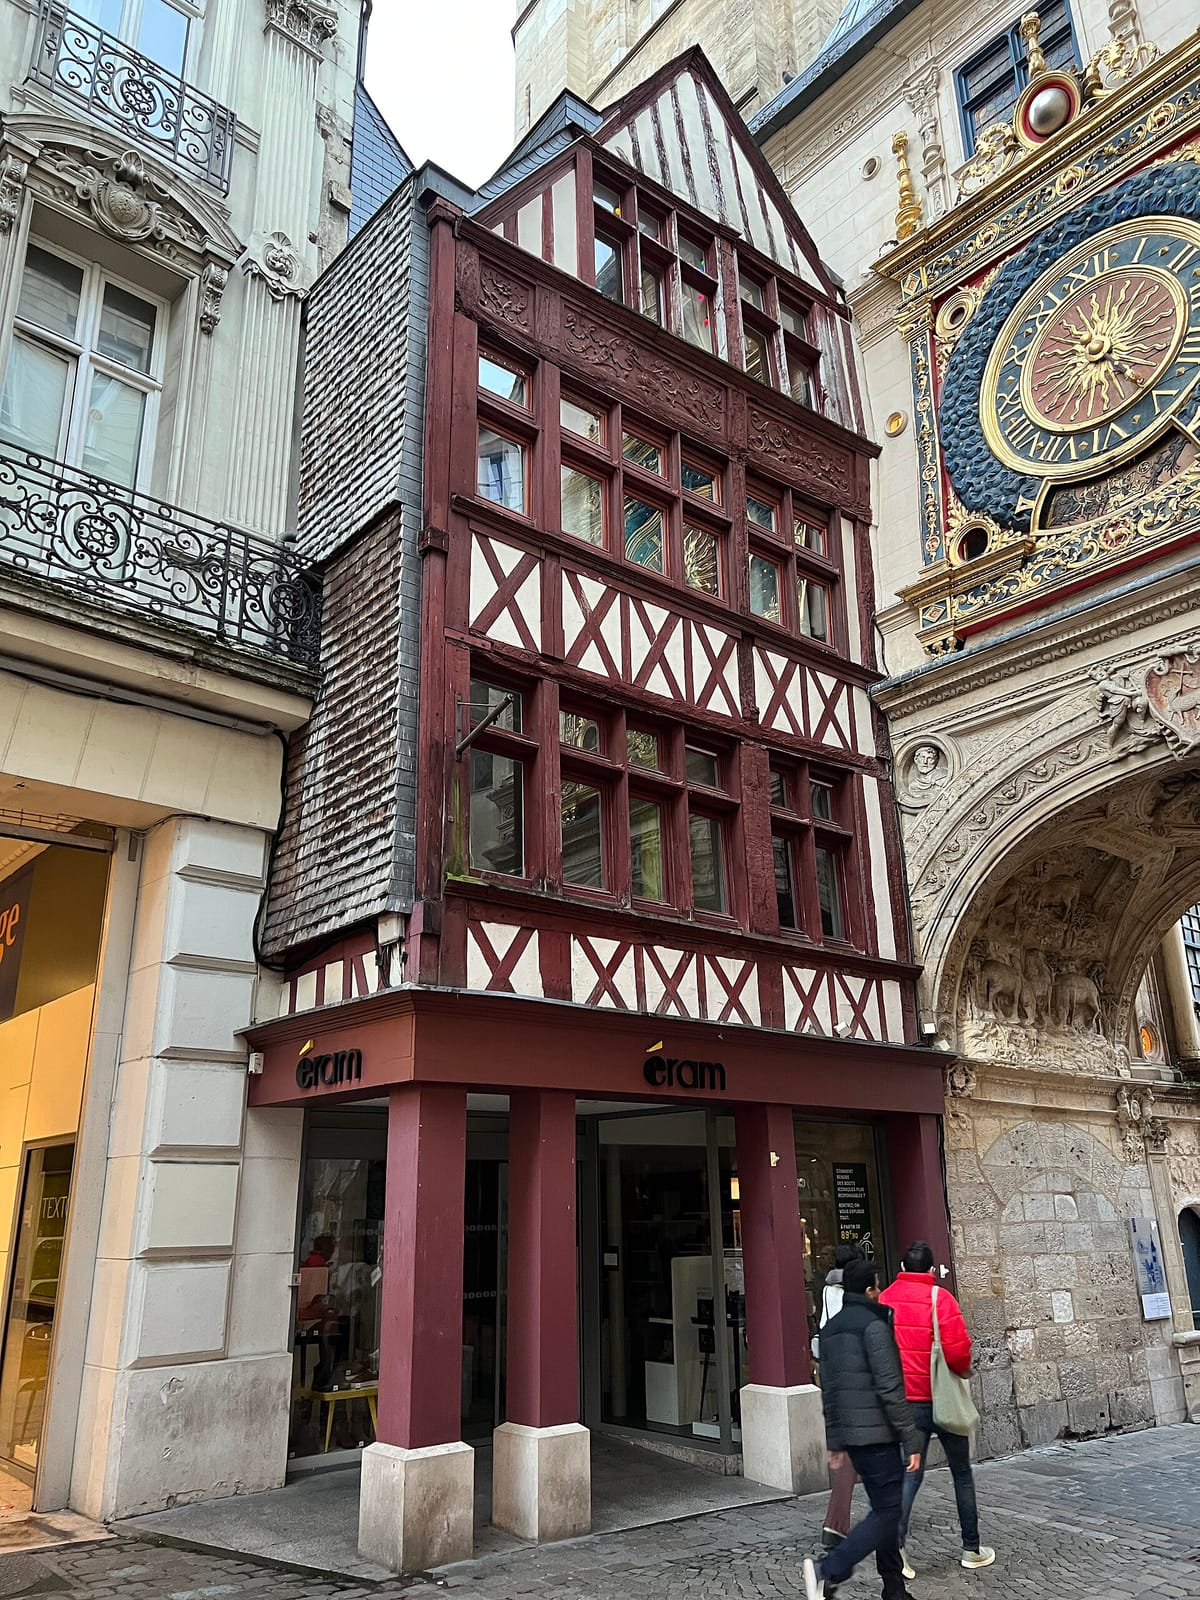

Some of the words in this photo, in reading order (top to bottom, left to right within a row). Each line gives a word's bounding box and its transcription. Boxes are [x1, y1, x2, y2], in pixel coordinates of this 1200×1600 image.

[295, 1040, 362, 1089] éram
[642, 1040, 726, 1091] éram
[42, 1196, 69, 1219] TEXT
